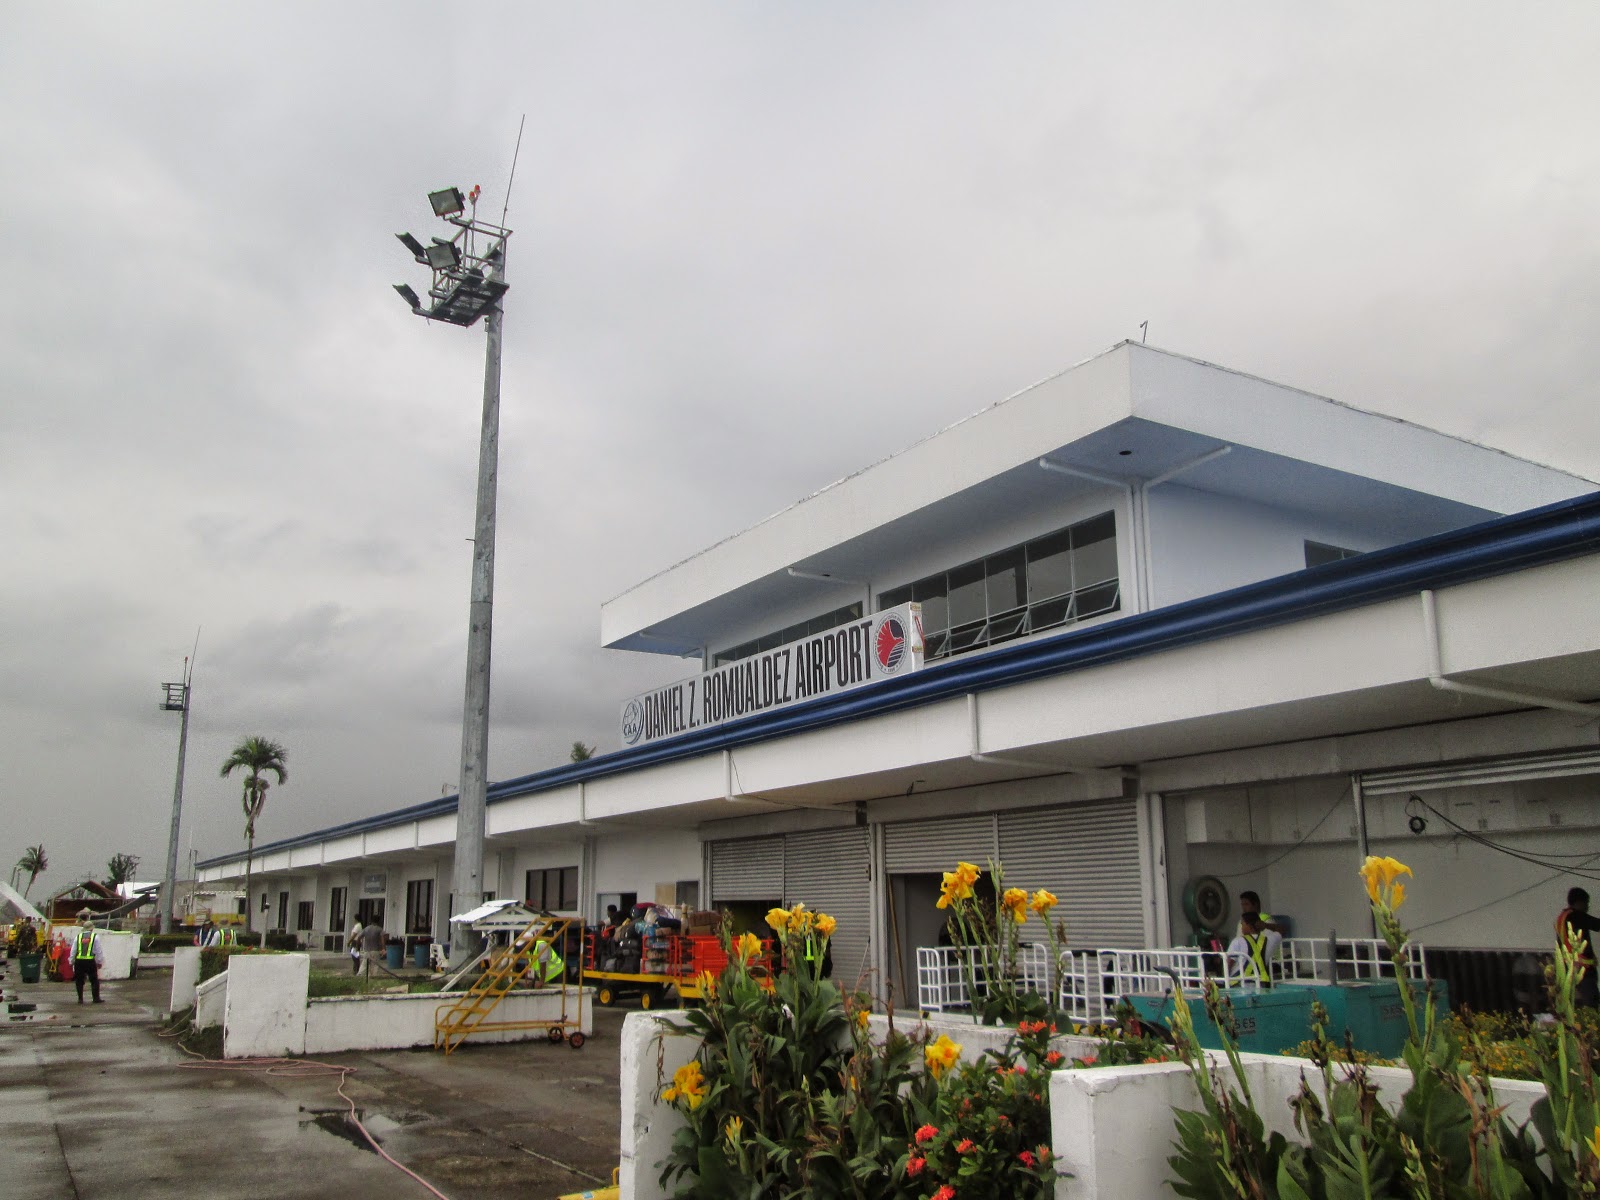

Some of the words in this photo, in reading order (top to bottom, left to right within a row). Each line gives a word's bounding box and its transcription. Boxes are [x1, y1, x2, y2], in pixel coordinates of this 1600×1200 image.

[645, 684, 686, 740] DANIEL
[689, 680, 700, 728] Z.
[703, 648, 791, 724] ROMUALDEZ
[795, 620, 872, 700] AIRPORT
